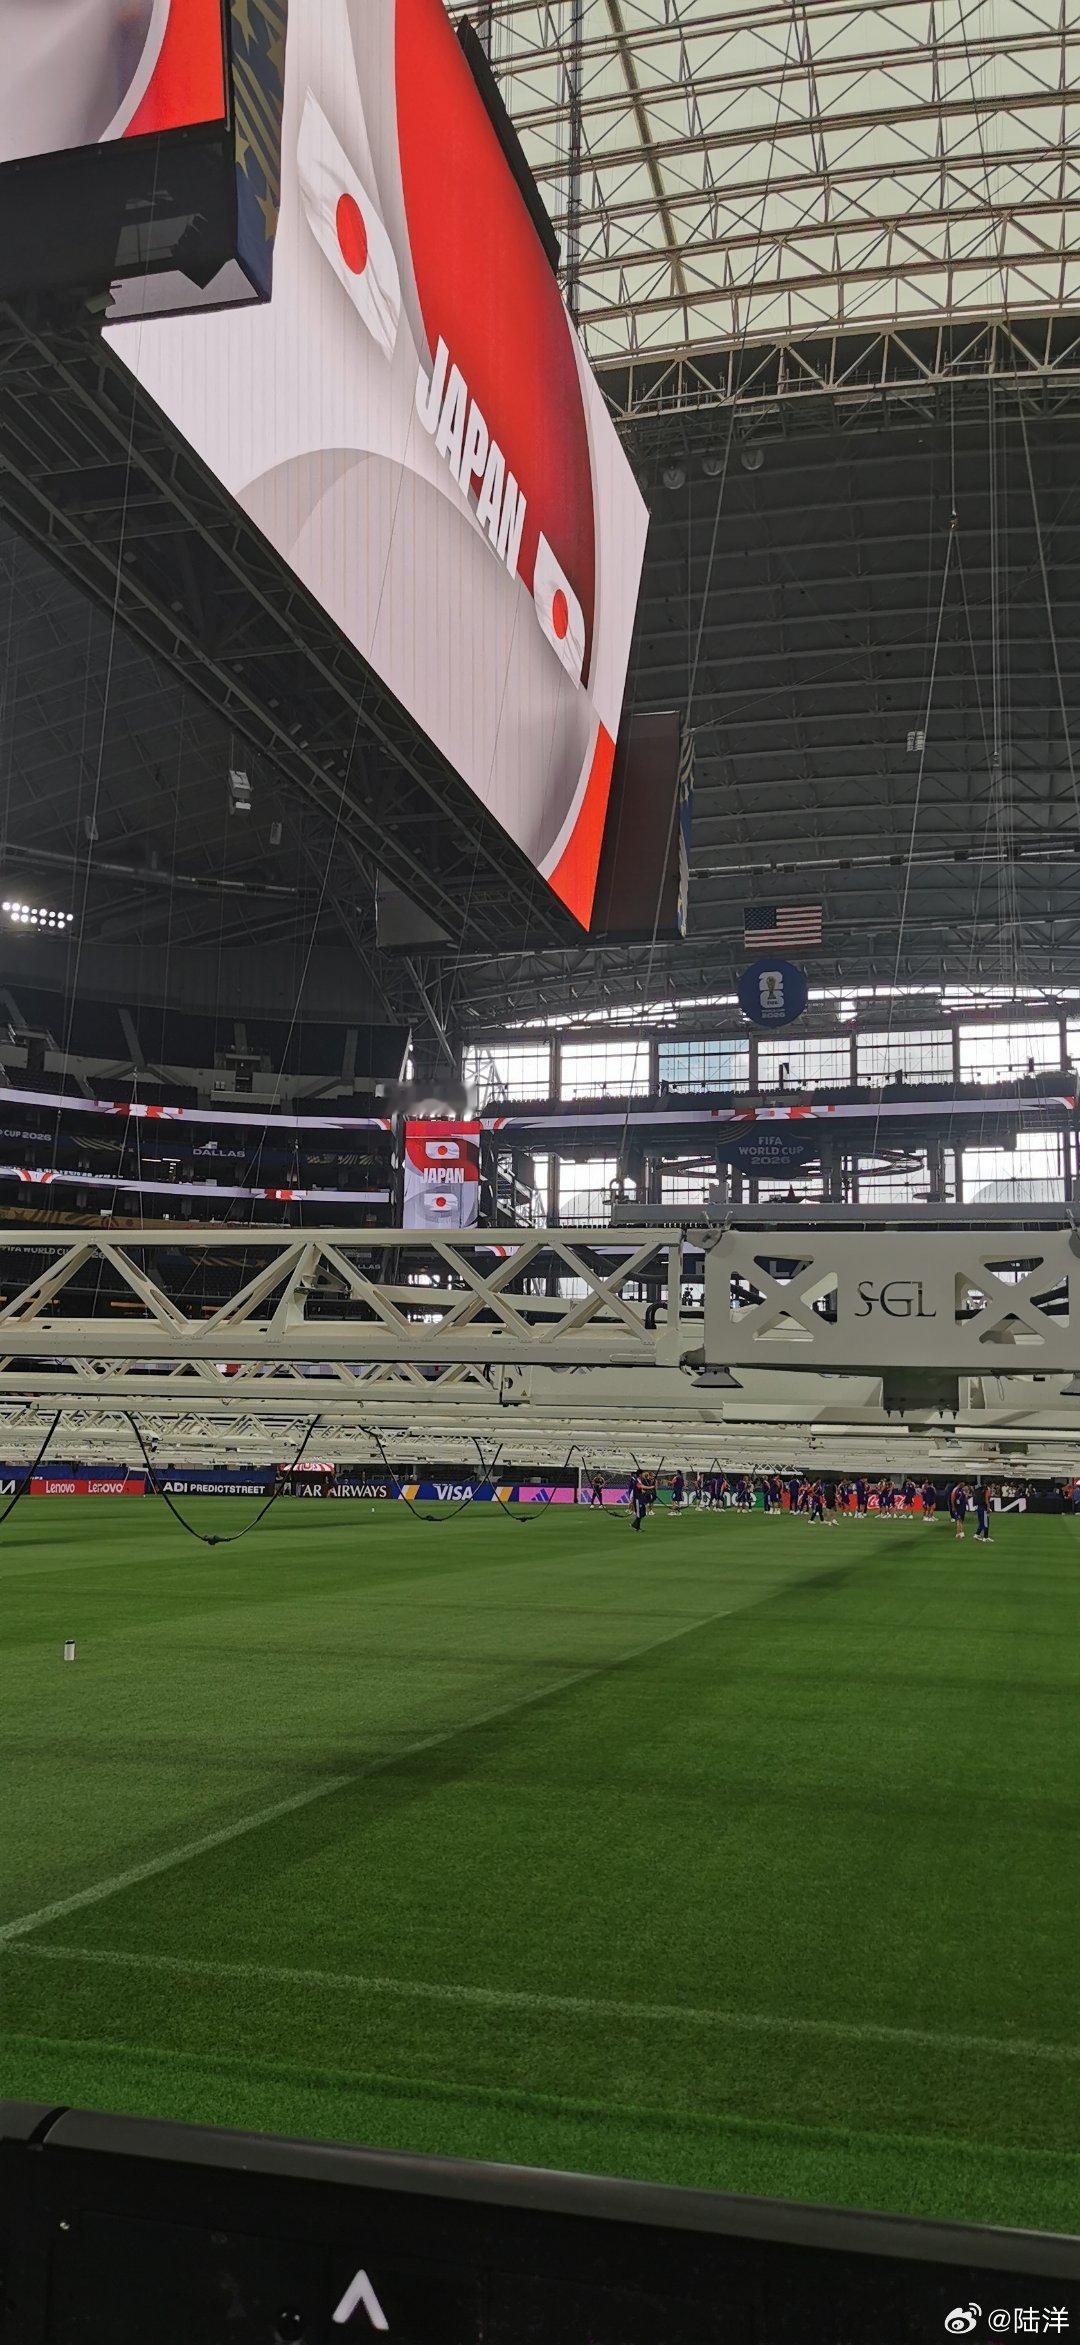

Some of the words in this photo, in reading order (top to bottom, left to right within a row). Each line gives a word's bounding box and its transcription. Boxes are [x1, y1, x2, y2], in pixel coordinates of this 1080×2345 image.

[415, 334, 527, 580] JAPAN
[4, 1129, 21, 1138] CUP
[22, 1131, 52, 1142] 2026
[758, 1136, 783, 1145] FIFA
[193, 1148, 246, 1158] DALLAS
[739, 1146, 780, 1155] WORLD
[781, 1146, 804, 1154] CUP
[751, 1157, 791, 1165] 2026
[421, 1168, 464, 1184] JAPAN
[855, 1281, 936, 1317] SGL
[46, 1480, 76, 1494] Lenovo
[88, 1480, 123, 1493] Lenovo
[163, 1482, 188, 1493] ADI
[190, 1484, 265, 1494] PREDICTSTREET
[329, 1485, 387, 1498] AIRWAYS
[435, 1485, 474, 1501] VISA
